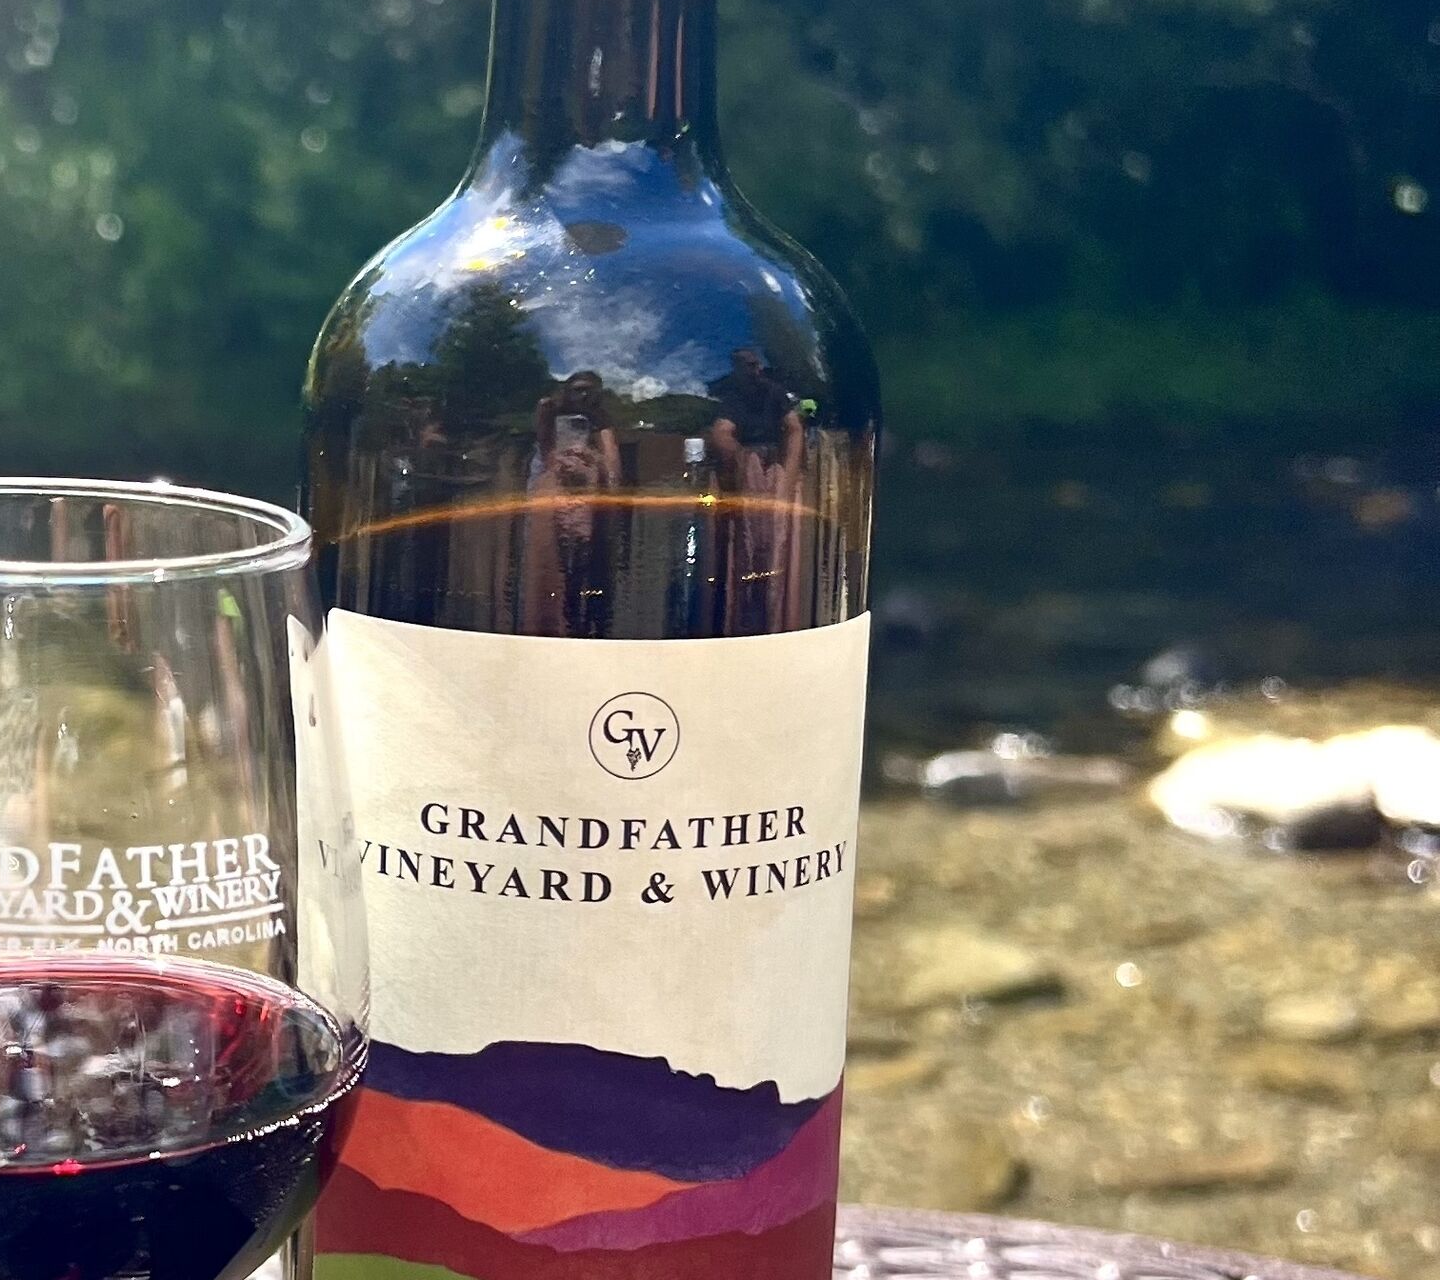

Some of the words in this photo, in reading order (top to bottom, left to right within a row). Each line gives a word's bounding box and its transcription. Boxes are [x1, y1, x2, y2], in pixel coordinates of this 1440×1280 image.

[420, 803, 807, 851] GRANDFATHER
[641, 872, 674, 904] &
[697, 841, 847, 901] WINERY
[105, 890, 152, 935] &
[151, 870, 281, 918] WINERY
[96, 933, 178, 954] NORTH
[187, 918, 286, 950] CAROLINA
